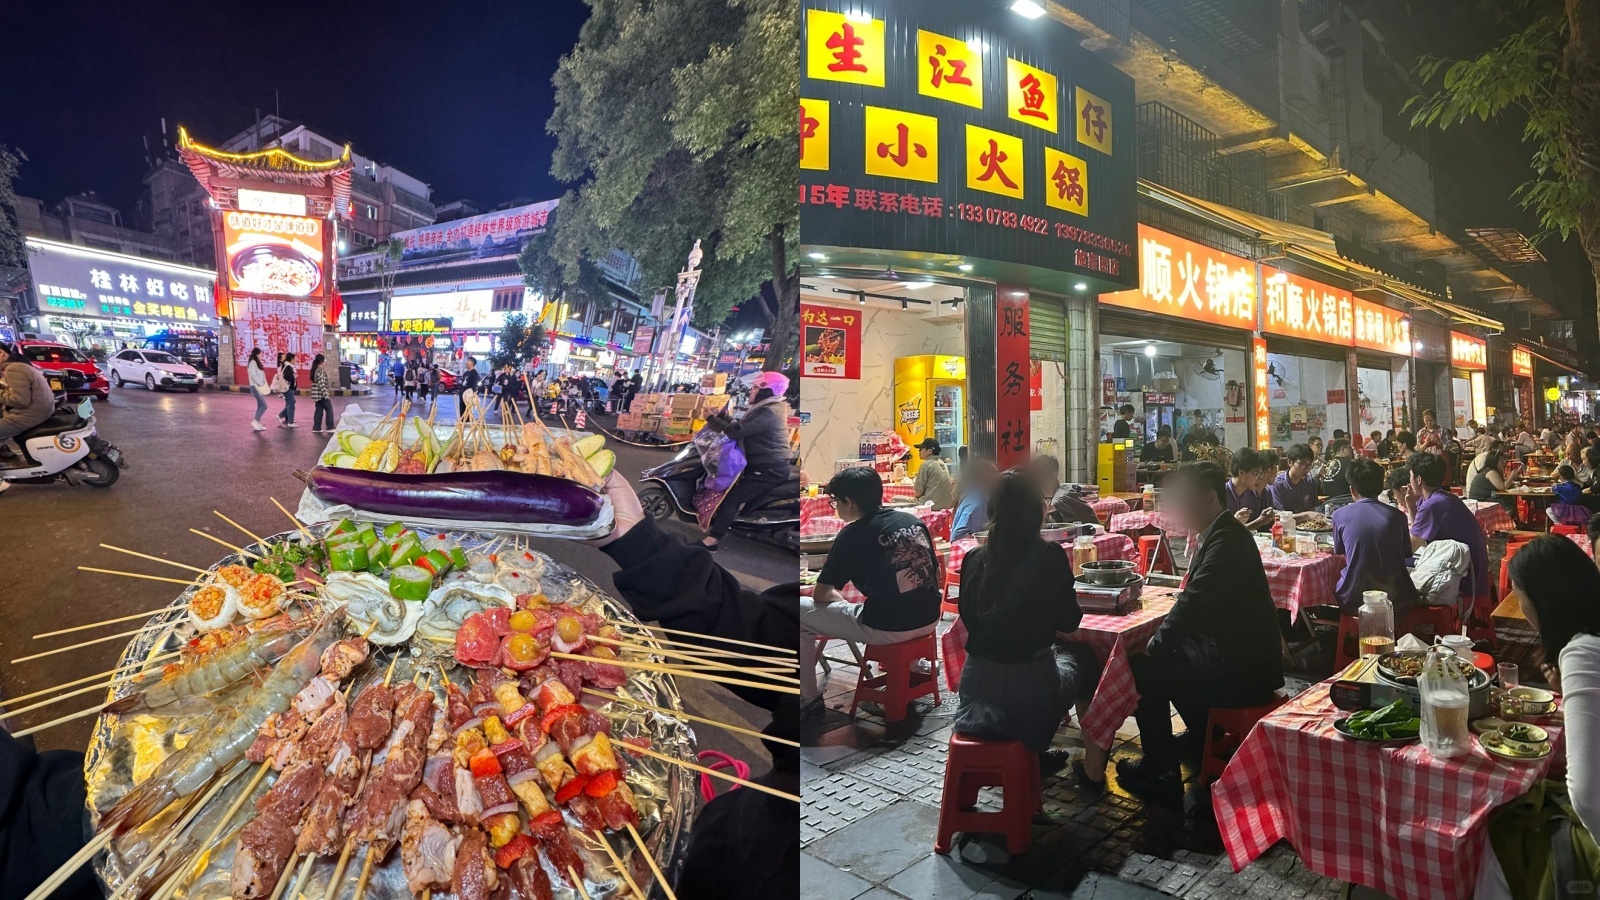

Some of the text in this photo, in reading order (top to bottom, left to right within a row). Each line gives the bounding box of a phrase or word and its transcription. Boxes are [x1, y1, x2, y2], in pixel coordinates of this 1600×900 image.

[825, 23, 1108, 144] 生江鱼仔
[958, 203, 983, 222] 133
[986, 208, 1017, 228] 0783
[1020, 215, 1049, 235] 4922
[89, 268, 210, 304] 桂林好吃街
[1266, 275, 1352, 340] 和顺火锅店
[802, 308, 855, 326] 为这一口
[1000, 306, 1027, 453] 服务社
